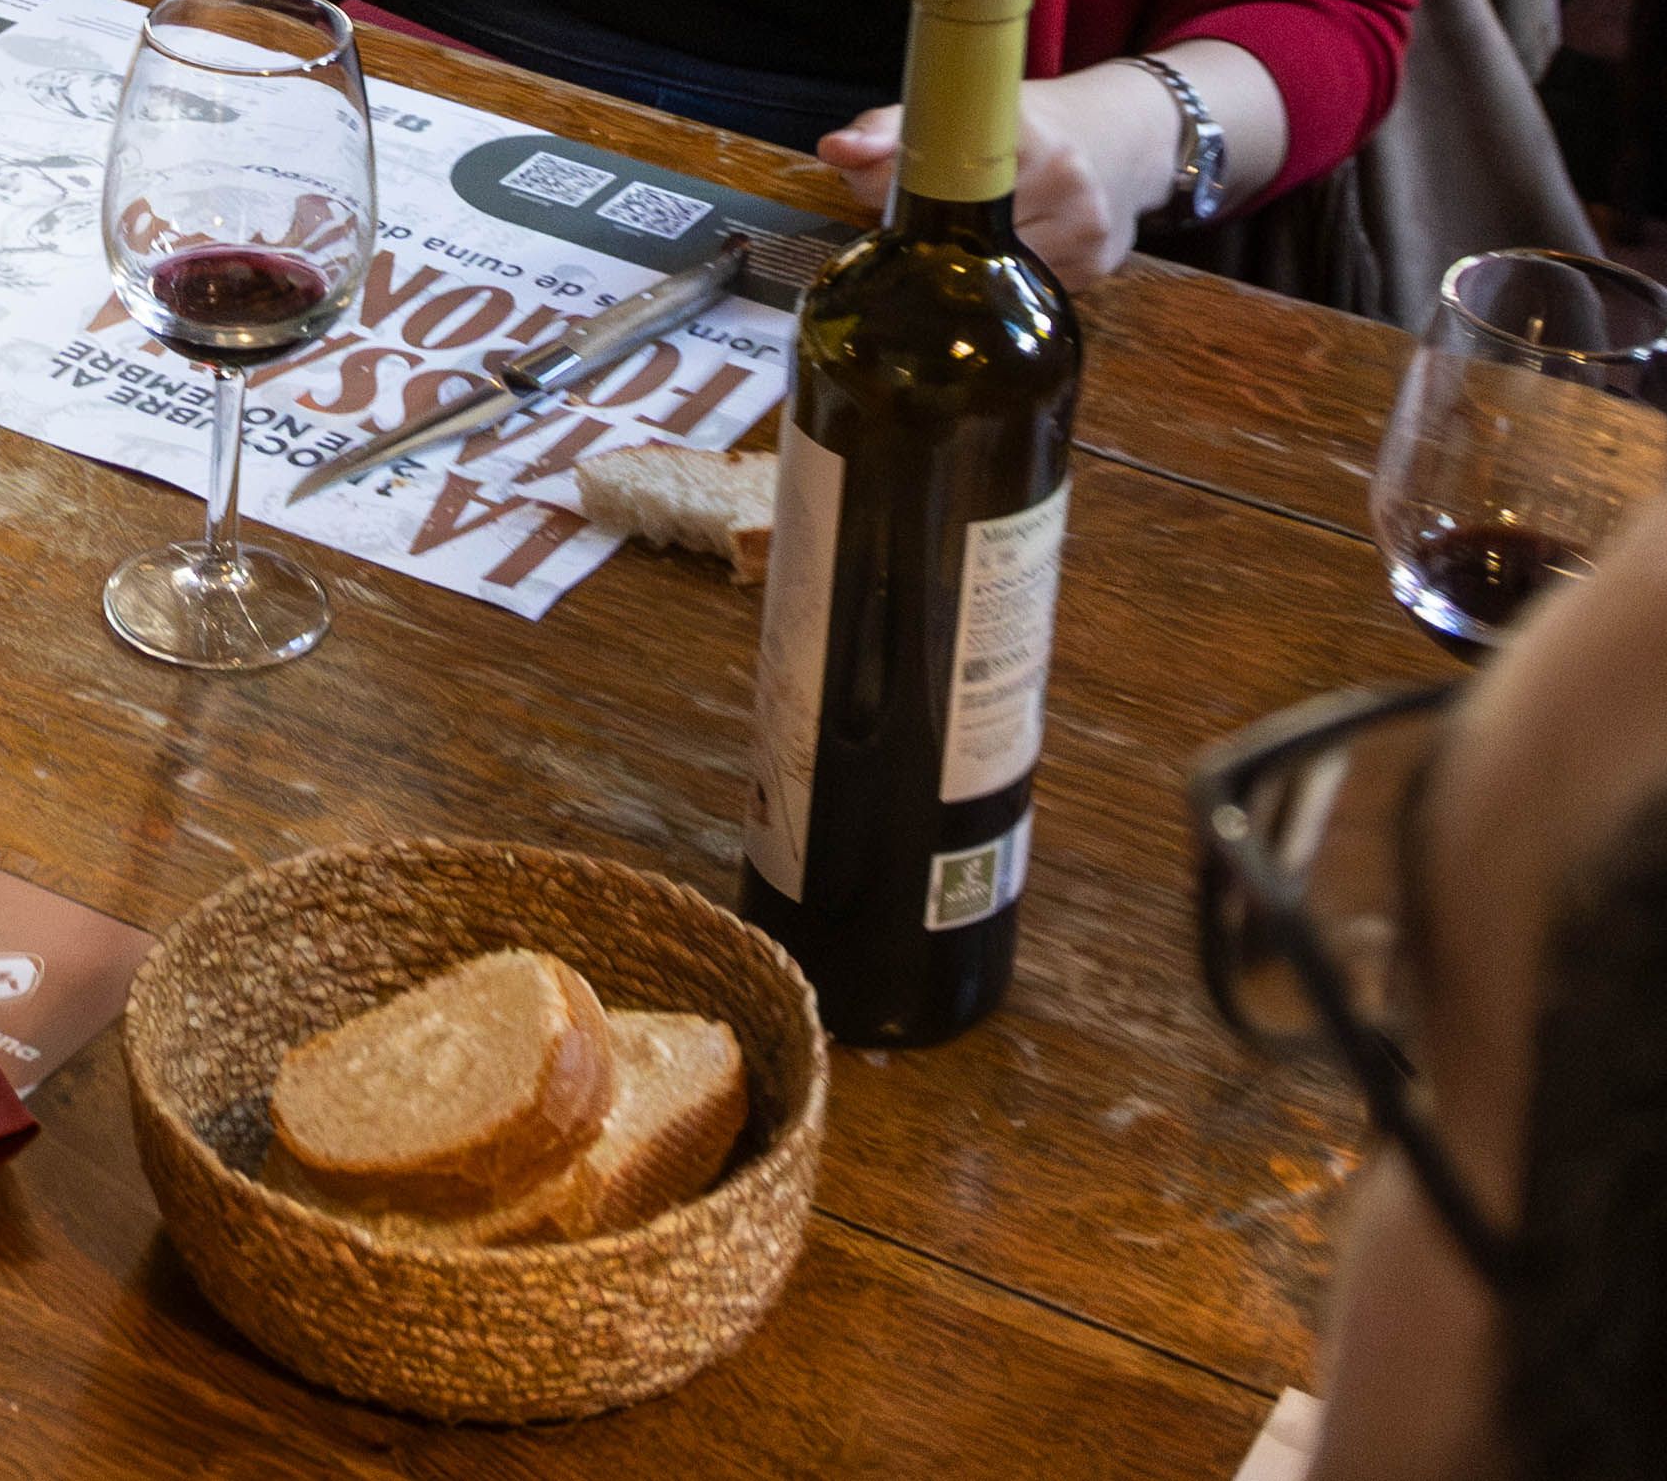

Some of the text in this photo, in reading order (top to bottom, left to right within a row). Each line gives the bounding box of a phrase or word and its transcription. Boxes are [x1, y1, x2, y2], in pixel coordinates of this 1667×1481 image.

[423, 235, 526, 280] cuina
[531, 270, 587, 298] de
[593, 293, 782, 361] Jorns
[51, 357, 107, 387] AL
[59, 340, 313, 439] NOEMBRE
[319, 431, 353, 453] E
